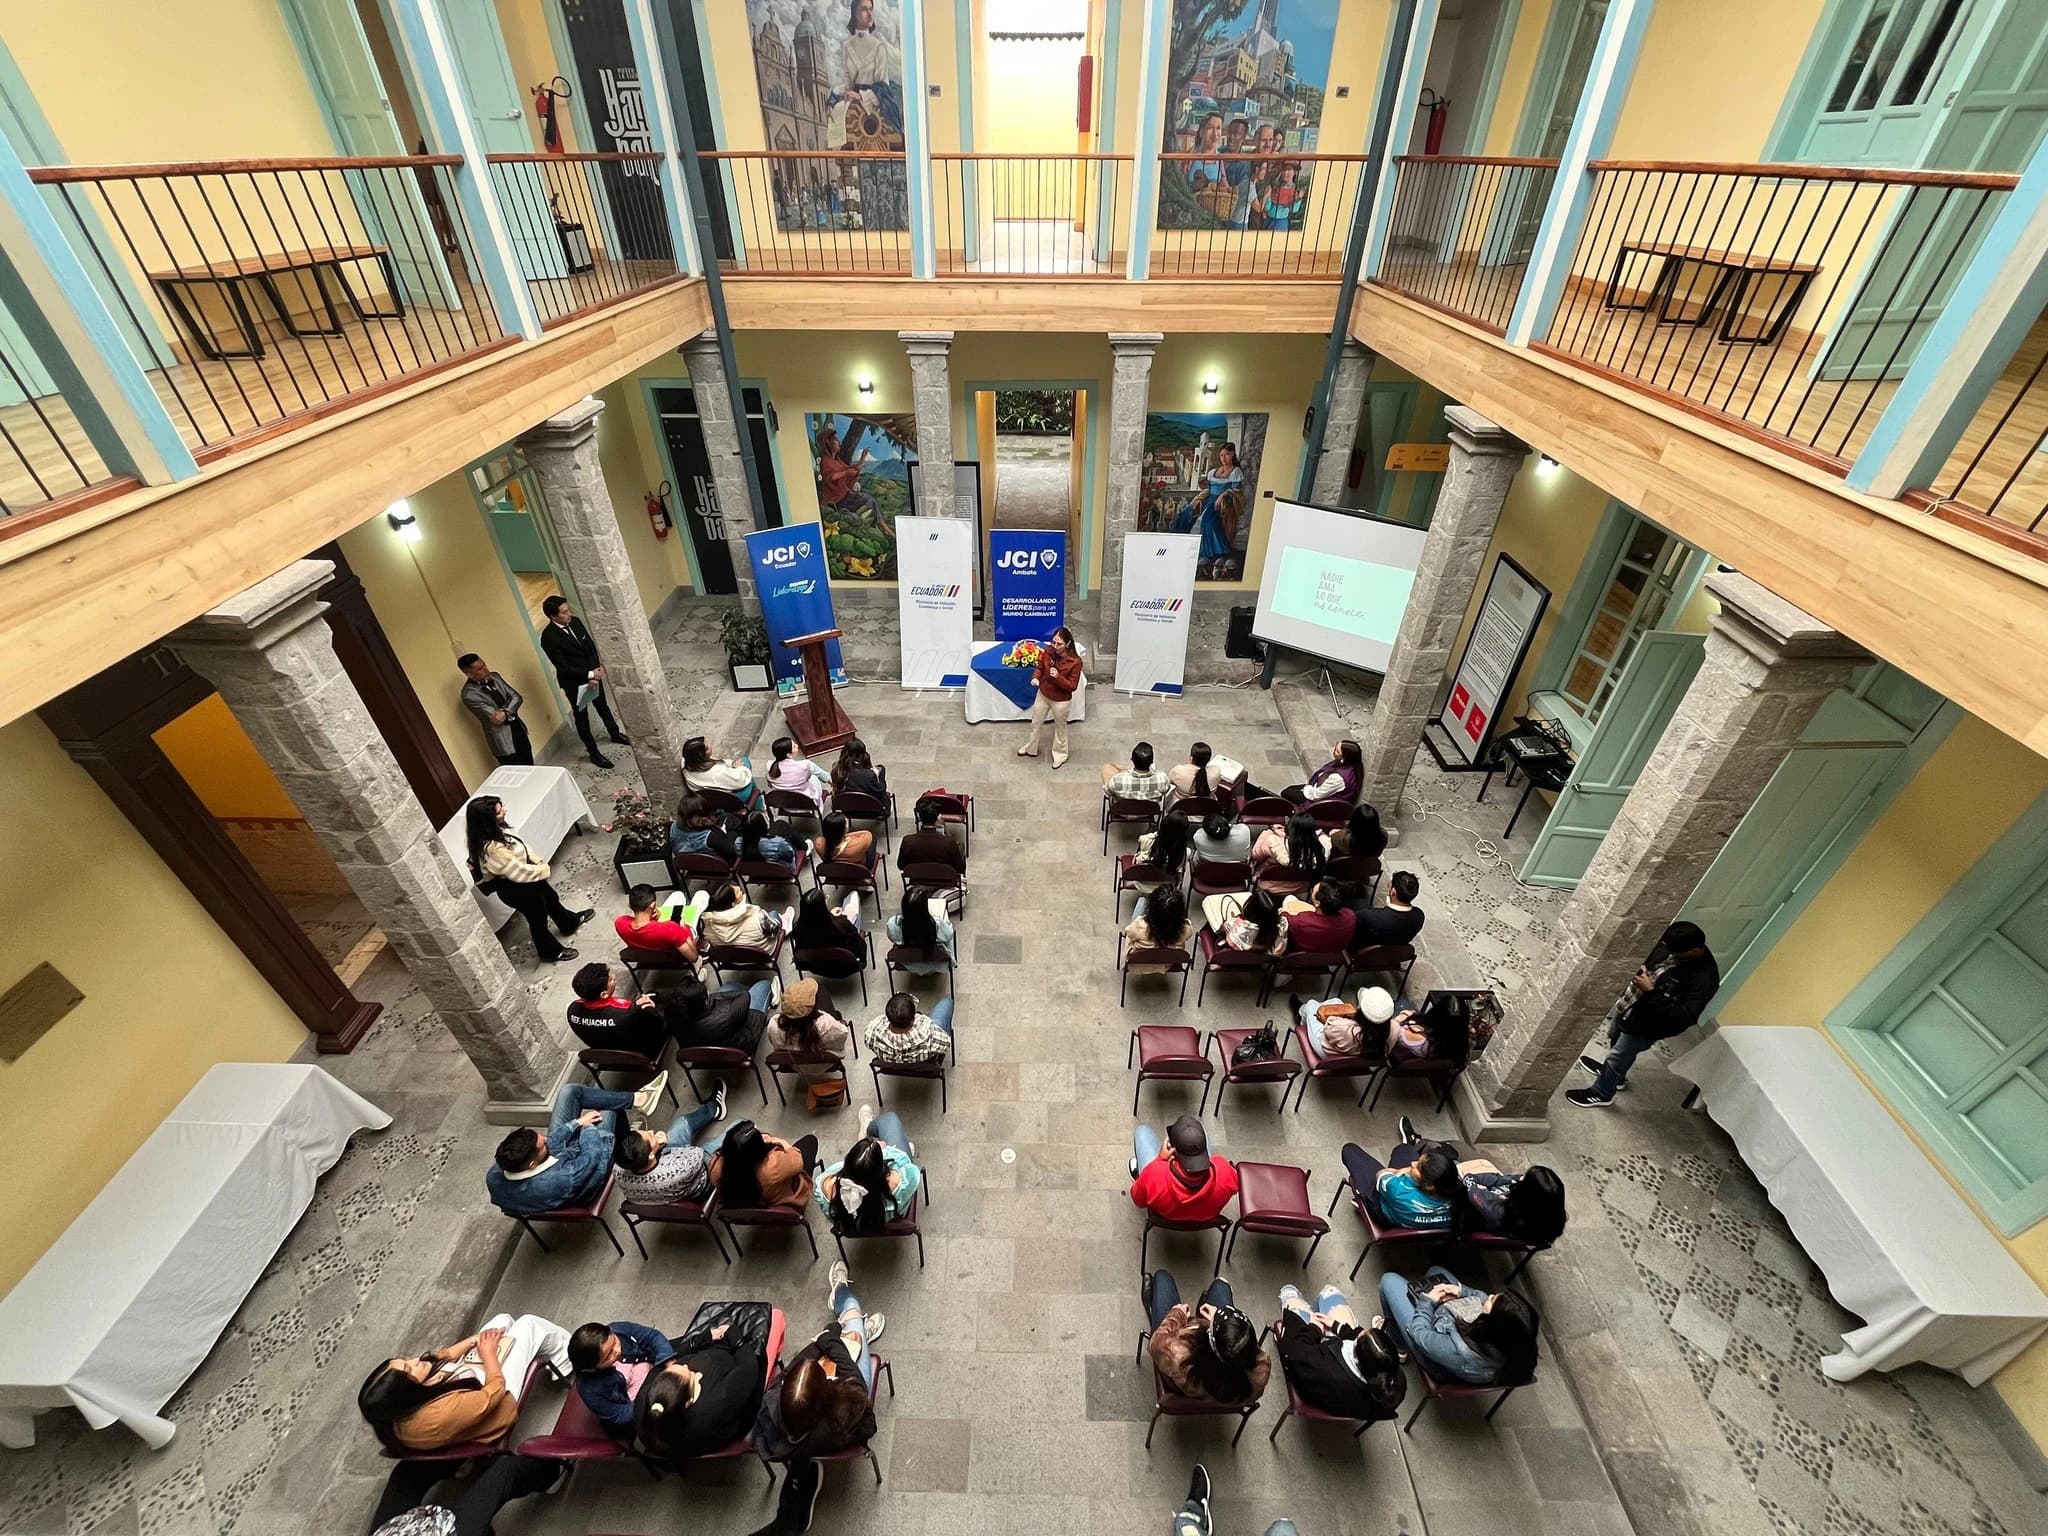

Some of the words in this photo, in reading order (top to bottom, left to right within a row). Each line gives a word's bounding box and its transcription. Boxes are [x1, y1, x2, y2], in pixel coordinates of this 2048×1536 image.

[762, 545, 795, 565] JCI
[997, 550, 1038, 568] JCI
[1320, 570, 1344, 584] NADIE
[910, 586, 944, 597] ECUADOR
[1318, 580, 1335, 592] AMA
[1315, 590, 1326, 601] LO
[1326, 592, 1343, 605] QUE
[1130, 599, 1166, 610] ECUADOR
[582, 1018, 607, 1027] HUACHI
